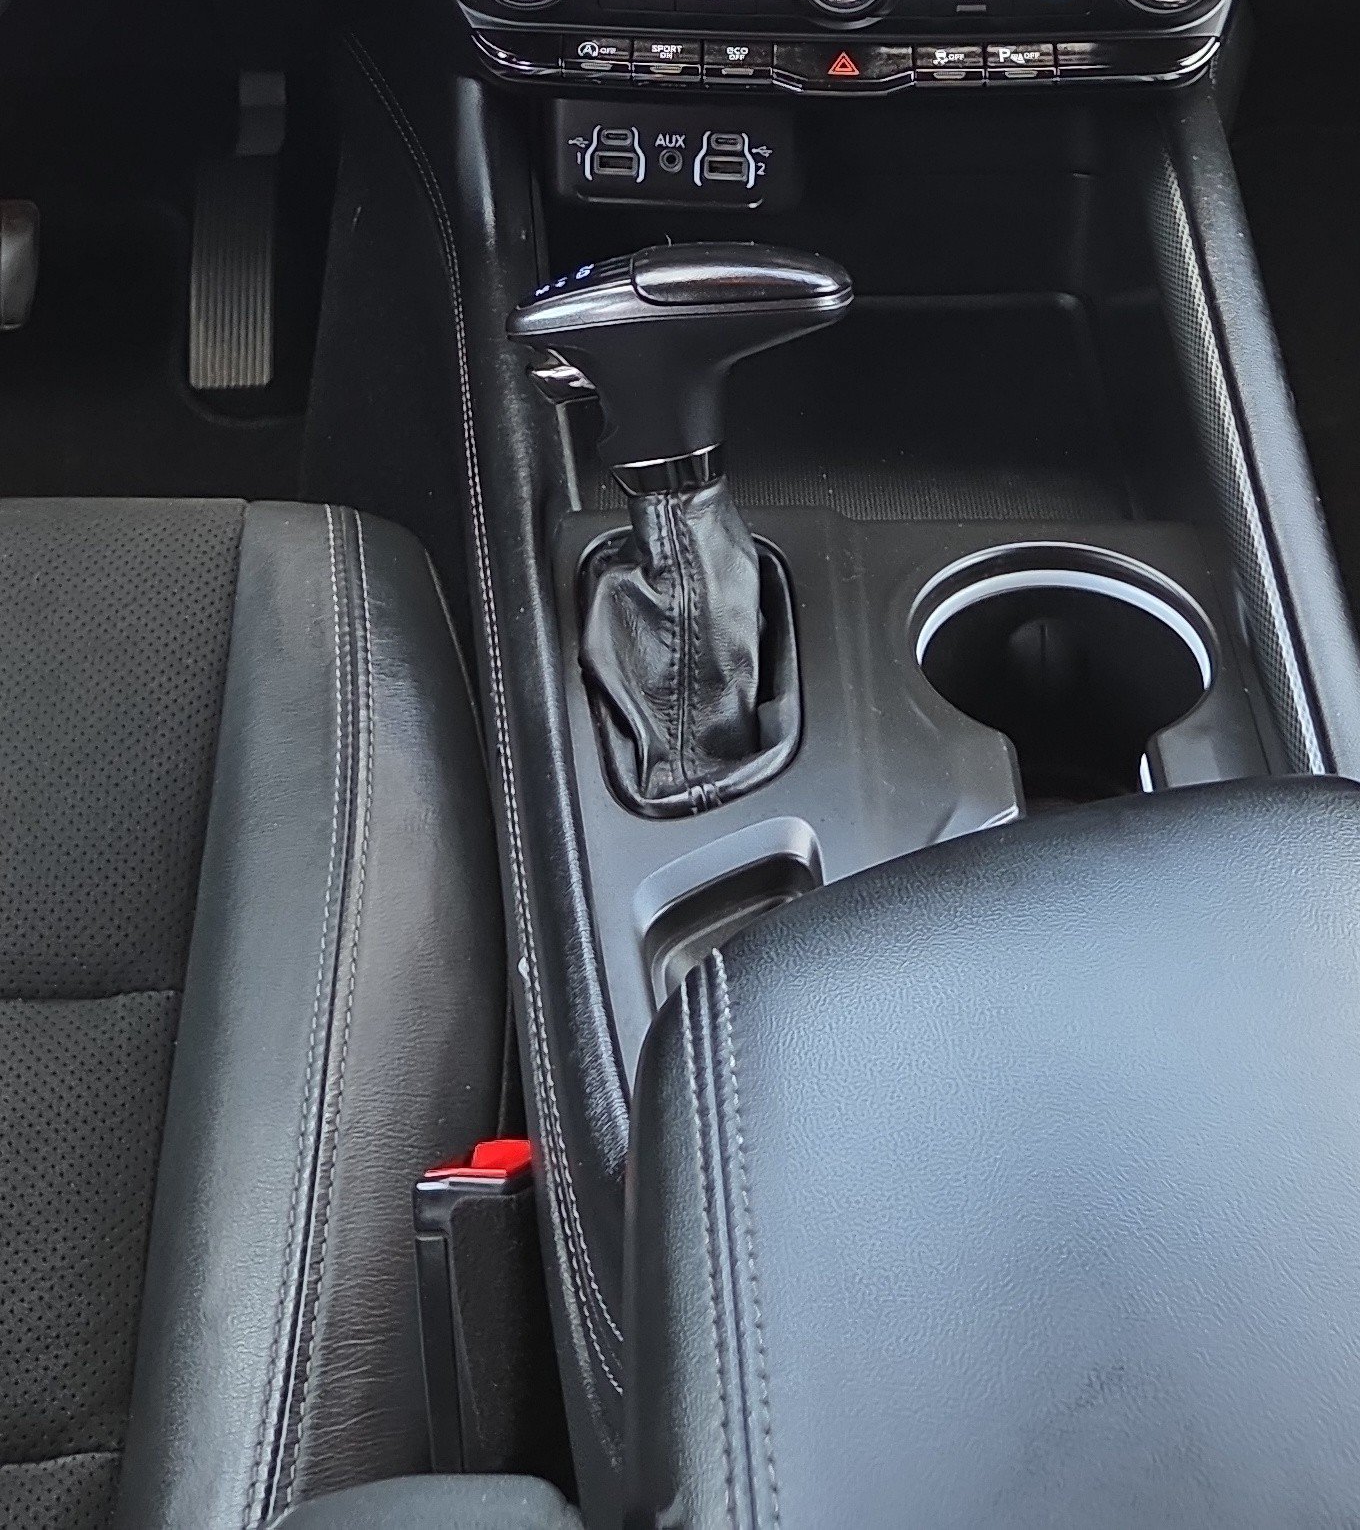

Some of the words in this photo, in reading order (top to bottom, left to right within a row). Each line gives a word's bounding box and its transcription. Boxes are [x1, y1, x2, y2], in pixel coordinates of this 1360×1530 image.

[599, 47, 616, 55] OFF
[651, 44, 683, 53] SPORT
[948, 53, 965, 61] OFF
[1023, 52, 1040, 60] OFF
[654, 132, 686, 149] AUX
[756, 162, 766, 176] 2
